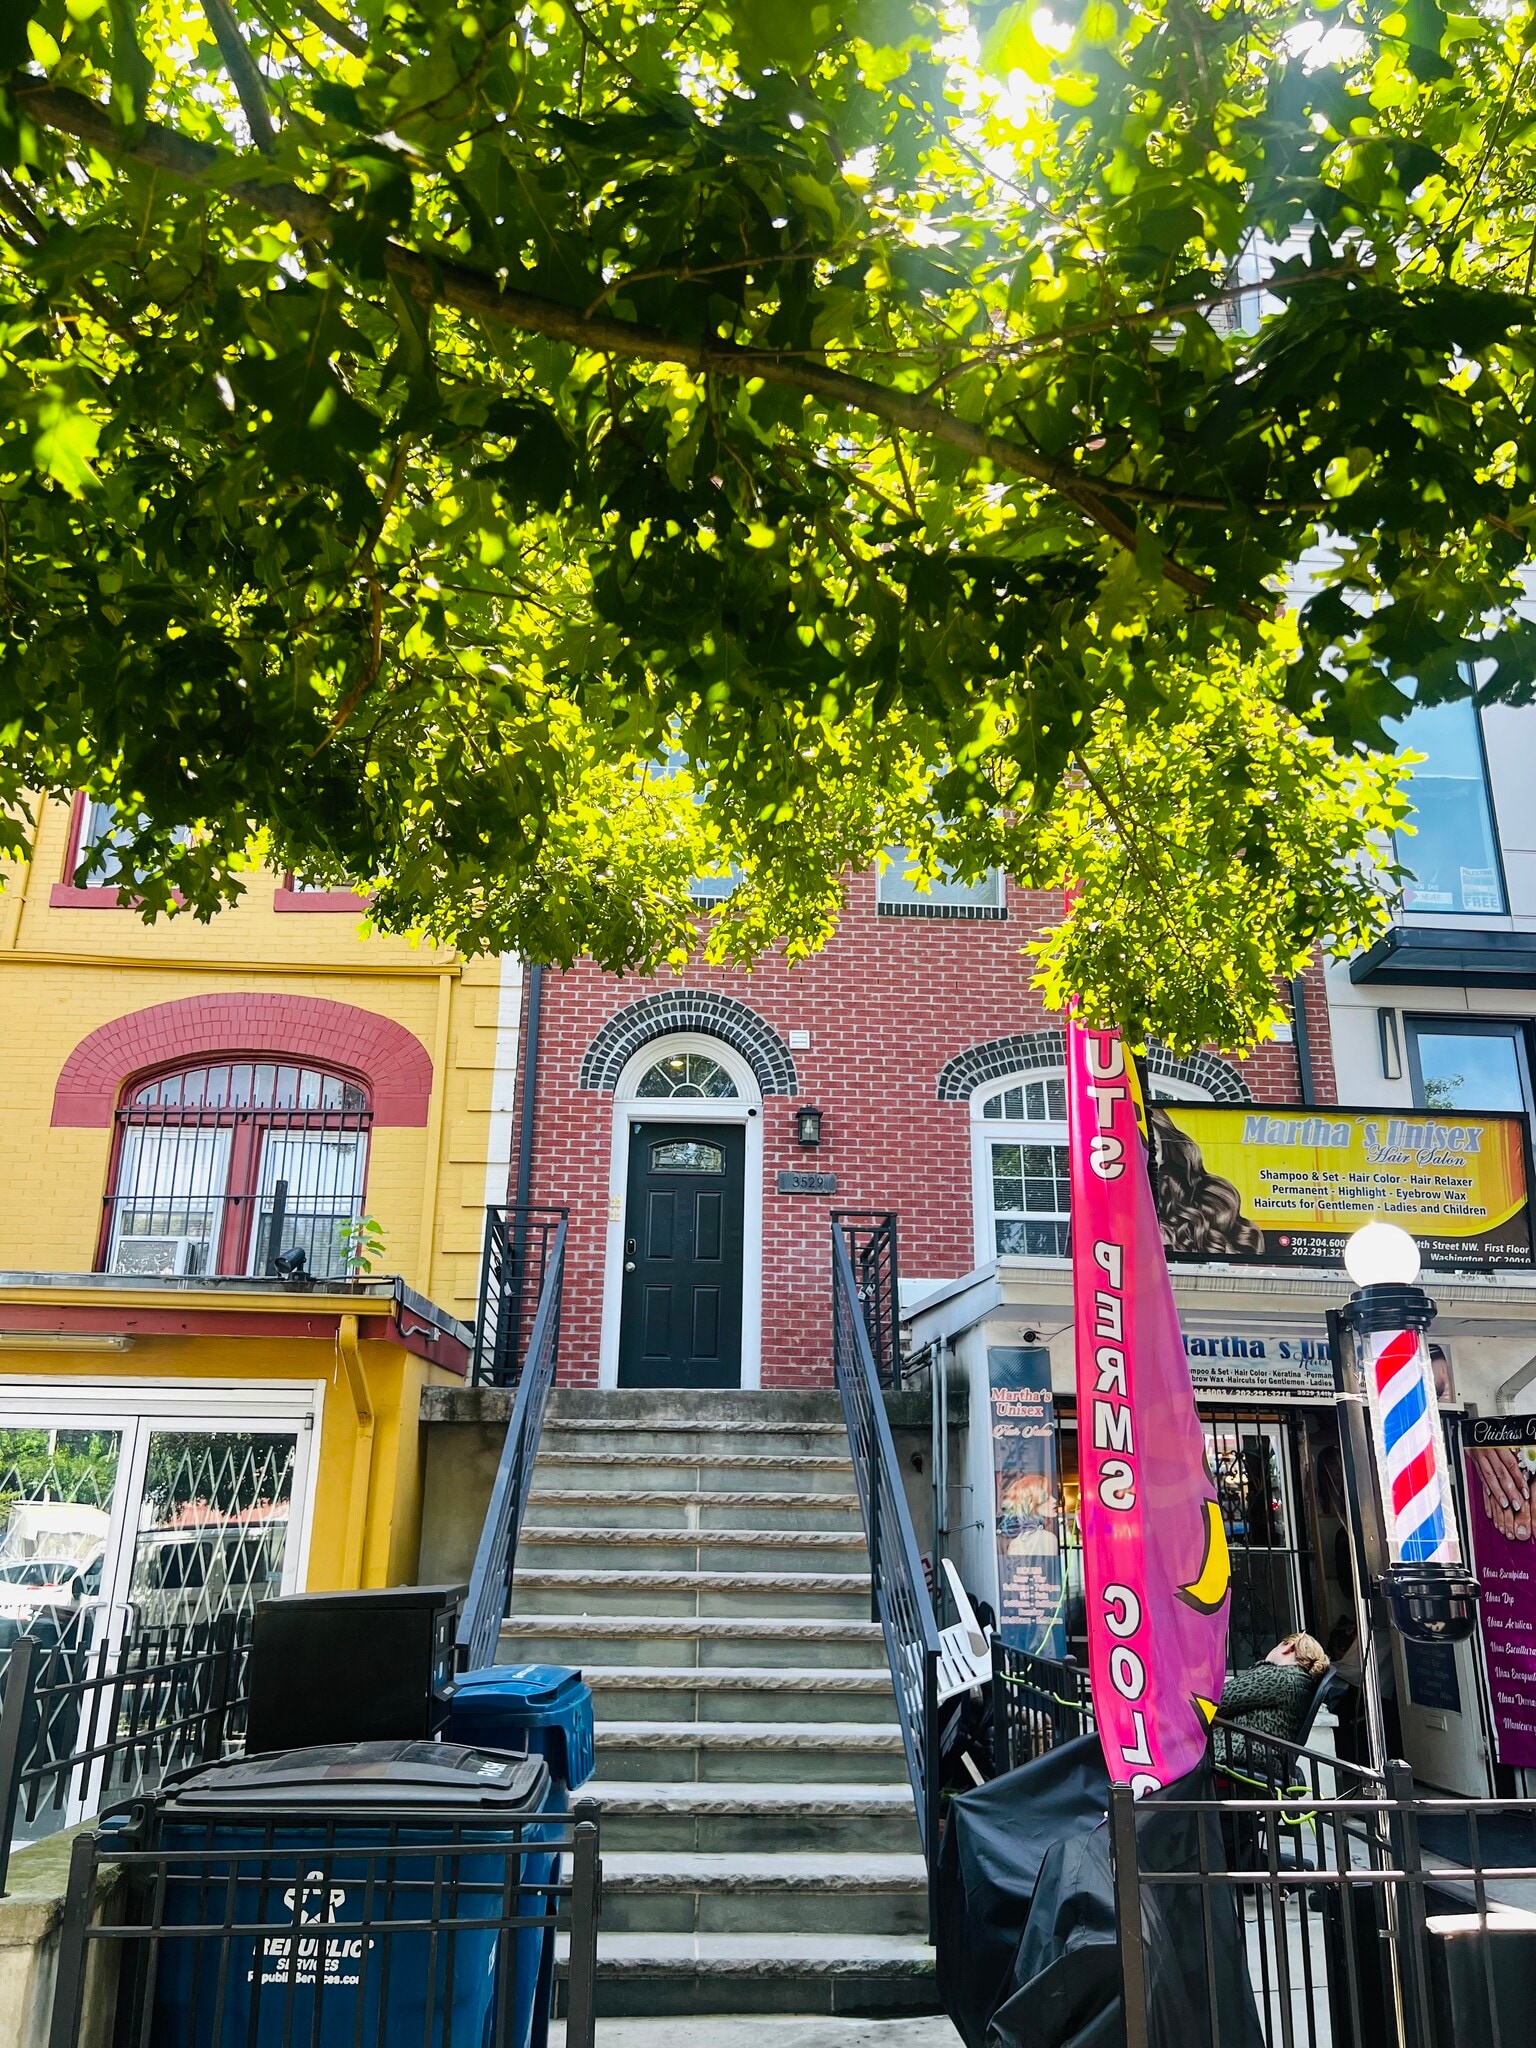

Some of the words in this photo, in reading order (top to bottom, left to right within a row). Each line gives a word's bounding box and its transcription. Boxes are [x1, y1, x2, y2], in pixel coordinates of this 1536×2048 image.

[1464, 897, 1499, 909] FREE
[1387, 1119, 1483, 1153] Unisex
[1366, 1143, 1411, 1164] Hair
[1416, 1147, 1467, 1168] Salon
[792, 1176, 824, 1188] 3529
[1260, 1170, 1309, 1182] Shampoo
[1311, 1172, 1319, 1181] &
[1322, 1172, 1339, 1182] Set
[1348, 1173, 1370, 1182] Hair
[1373, 1174, 1400, 1183] Color
[1410, 1175, 1431, 1185] Hair
[1434, 1176, 1473, 1186] Relaxer
[1272, 1185, 1329, 1195] Permanent
[1338, 1186, 1387, 1198] Highlight
[1396, 1189, 1441, 1200] Eyebrow
[1444, 1191, 1466, 1200] Wax
[1254, 1198, 1297, 1208] Haircuts
[1300, 1199, 1315, 1208] for
[1318, 1200, 1374, 1211] Gentlemen
[1384, 1202, 1417, 1212] Ladies
[1420, 1204, 1440, 1213] and
[1443, 1204, 1487, 1215] Children
[1291, 1237, 1347, 1247] 301.204.600
[1416, 1240, 1430, 1249] 4th
[1432, 1240, 1459, 1251] Street
[1462, 1242, 1479, 1252] NW.
[1484, 1243, 1504, 1253] First
[1506, 1244, 1530, 1254] Floor
[1292, 1247, 1345, 1257] 202.291.321
[1218, 1368, 1229, 1376] Set
[1273, 1370, 1301, 1378] Keratina
[1269, 1378, 1305, 1386] Gentlemen
[1310, 1379, 1333, 1387] Ladies
[995, 1402, 1044, 1417] Unisex
